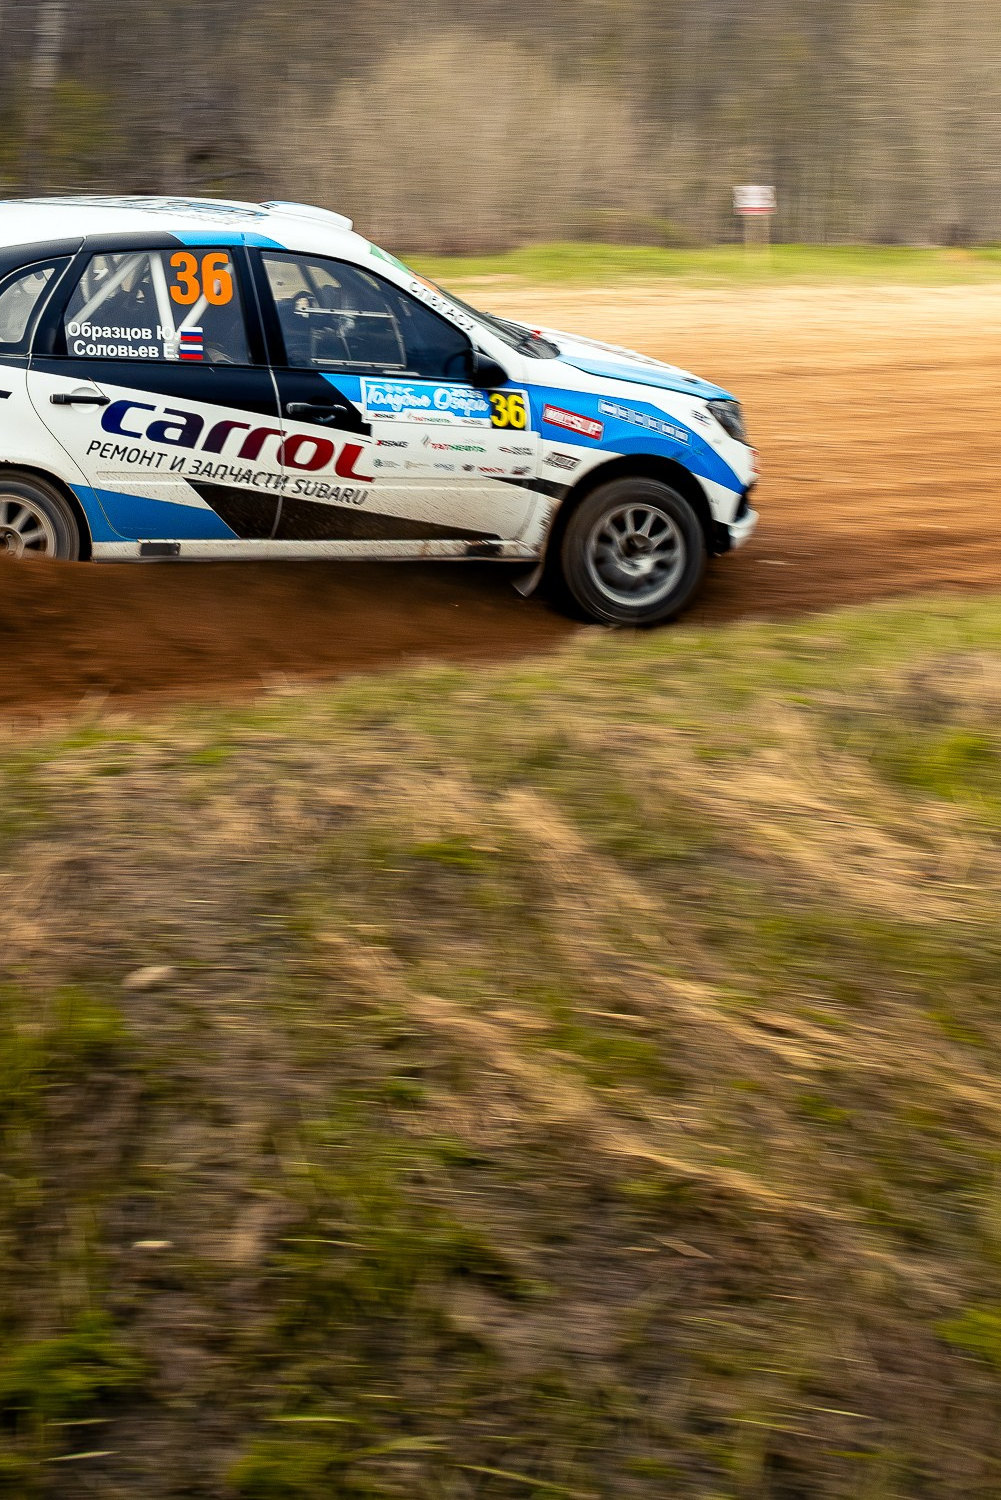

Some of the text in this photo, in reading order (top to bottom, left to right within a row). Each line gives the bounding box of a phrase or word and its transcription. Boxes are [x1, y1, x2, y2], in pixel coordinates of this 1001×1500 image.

[169, 251, 234, 306] 36
[67, 321, 181, 341] Образцов Ю.
[73, 339, 180, 359] Соловьев Е.
[489, 393, 527, 429] 36
[86, 439, 370, 506] РЕМОНТ И ЗАПЧАСТИ SUBARU
